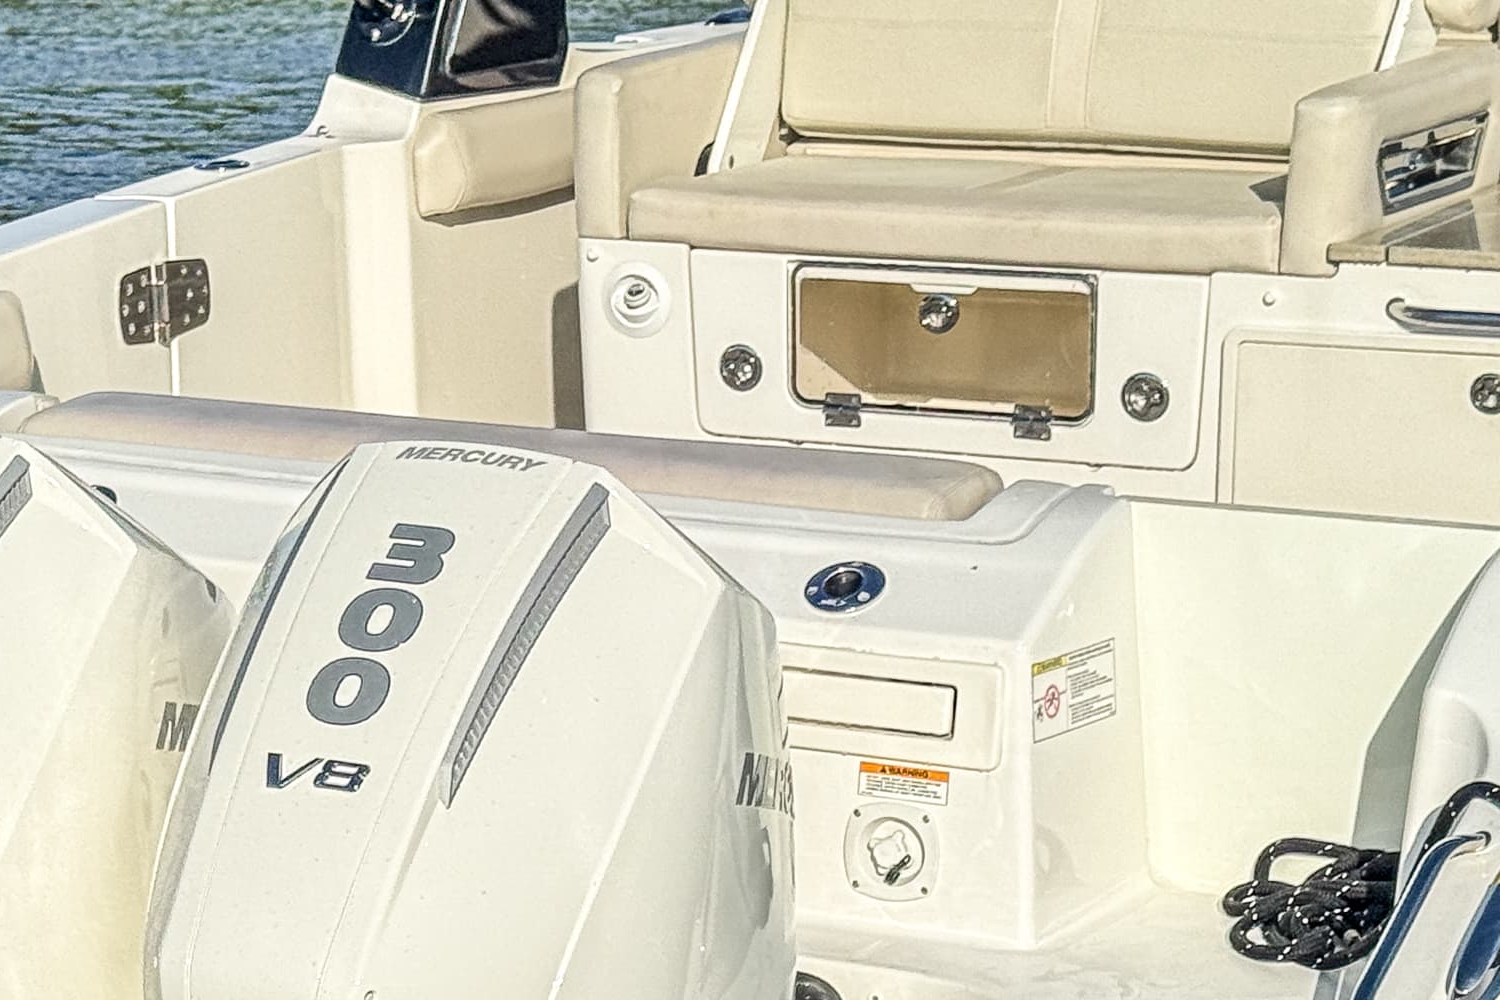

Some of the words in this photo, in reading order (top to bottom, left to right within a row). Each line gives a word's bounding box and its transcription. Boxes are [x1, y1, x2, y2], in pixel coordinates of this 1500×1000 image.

[396, 446, 548, 471] MERCURY
[306, 523, 455, 726] 300
[266, 752, 371, 792] V8
